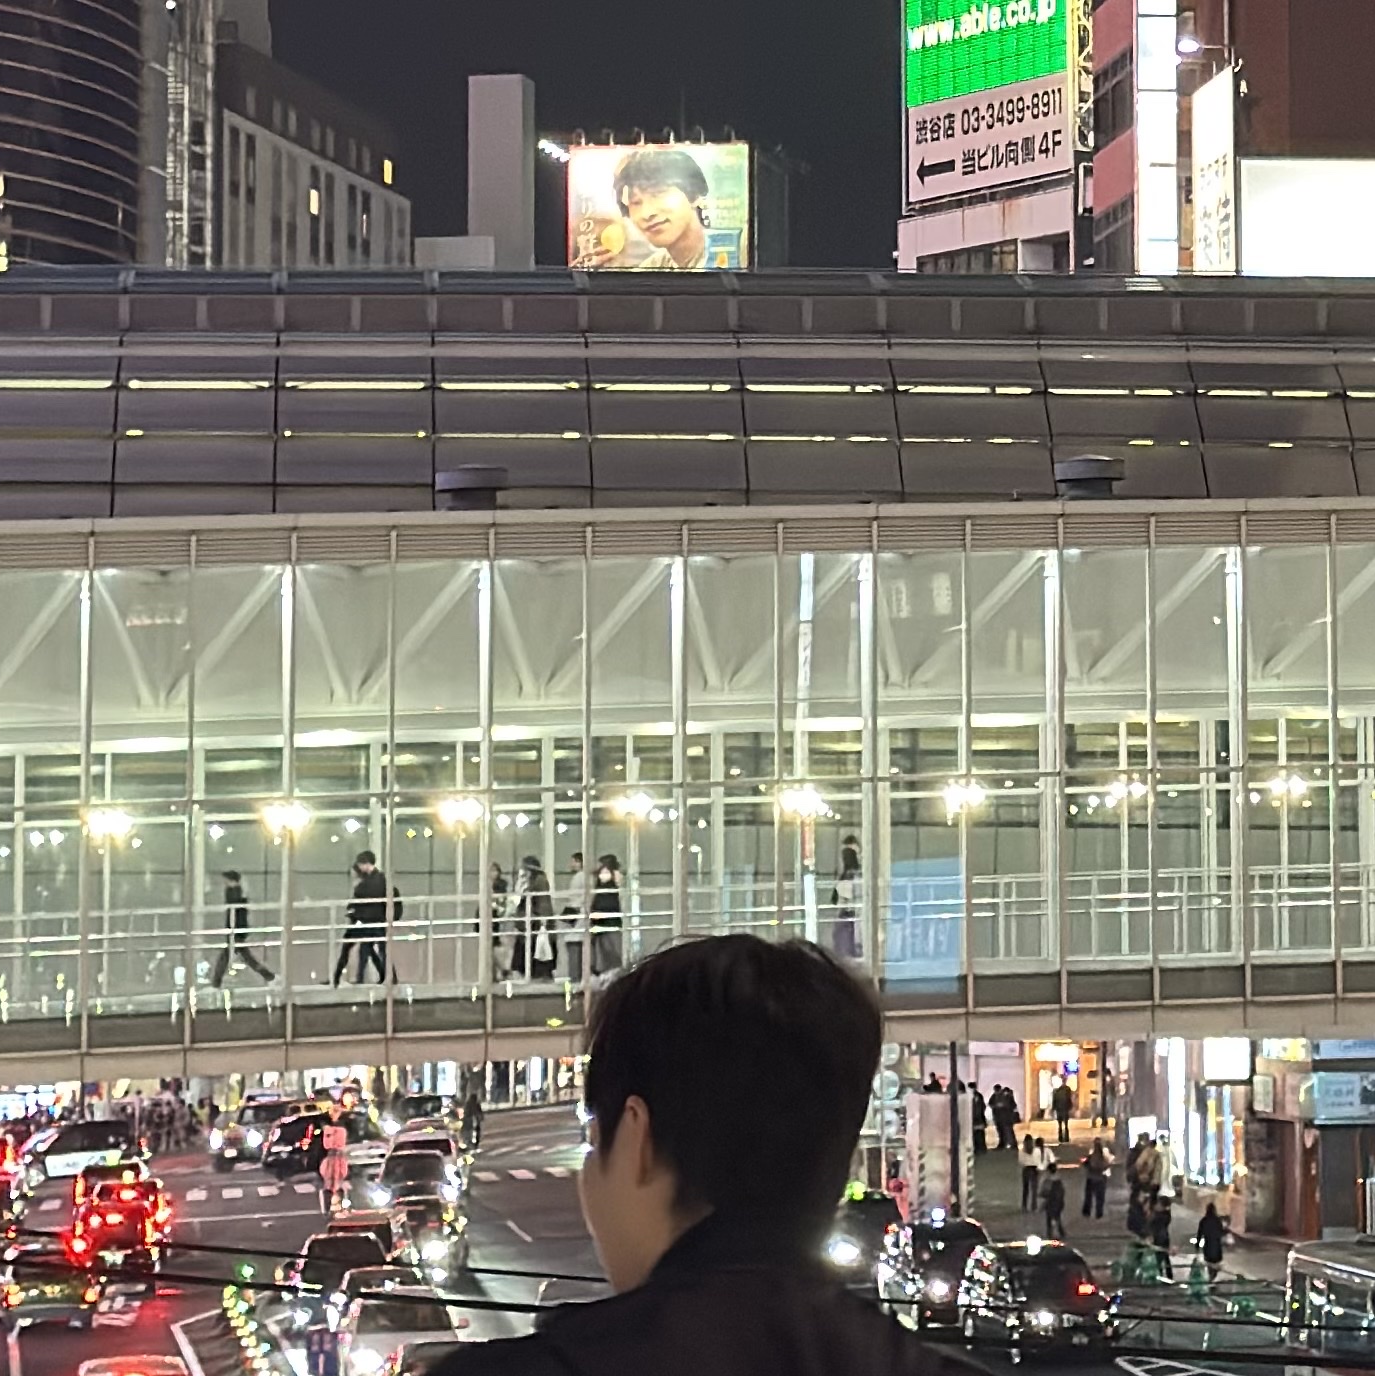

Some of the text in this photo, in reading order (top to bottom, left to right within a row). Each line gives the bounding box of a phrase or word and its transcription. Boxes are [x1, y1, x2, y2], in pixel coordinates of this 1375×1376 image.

[908, 0, 1057, 51] www.able.co.jp
[915, 87, 1063, 145] 渋谷店 03-3499-8911
